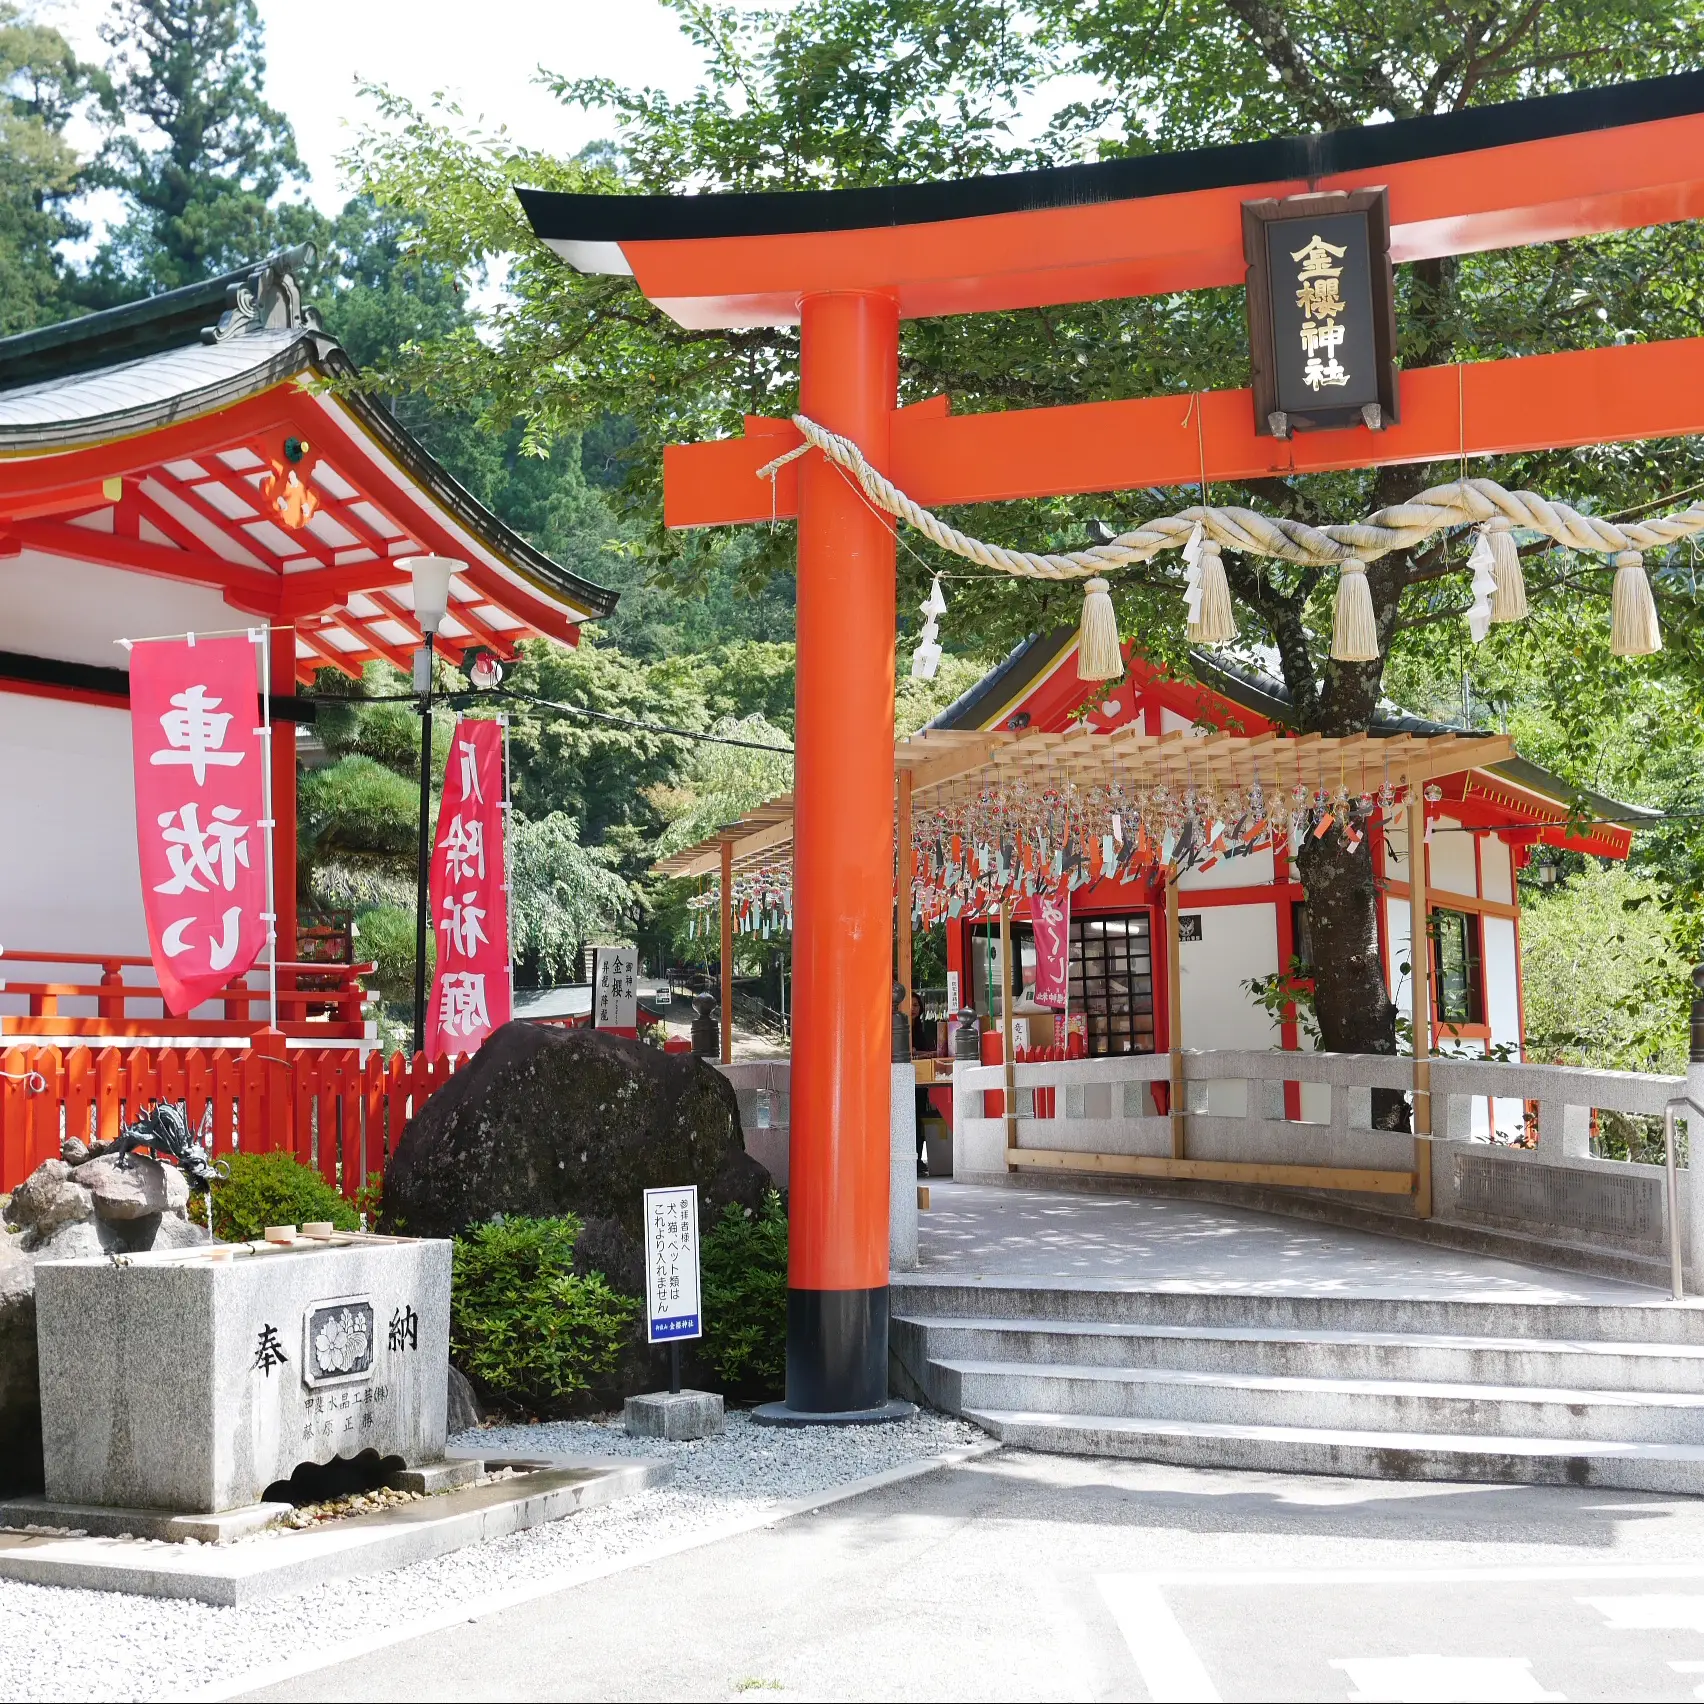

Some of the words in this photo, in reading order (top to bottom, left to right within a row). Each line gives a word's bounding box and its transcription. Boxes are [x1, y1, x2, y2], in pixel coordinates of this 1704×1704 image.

[1290, 234, 1350, 392] 金櫻神社
[654, 1204, 669, 1314] これより入れません
[250, 1323, 288, 1378] 奉
[388, 1304, 419, 1351] 納
